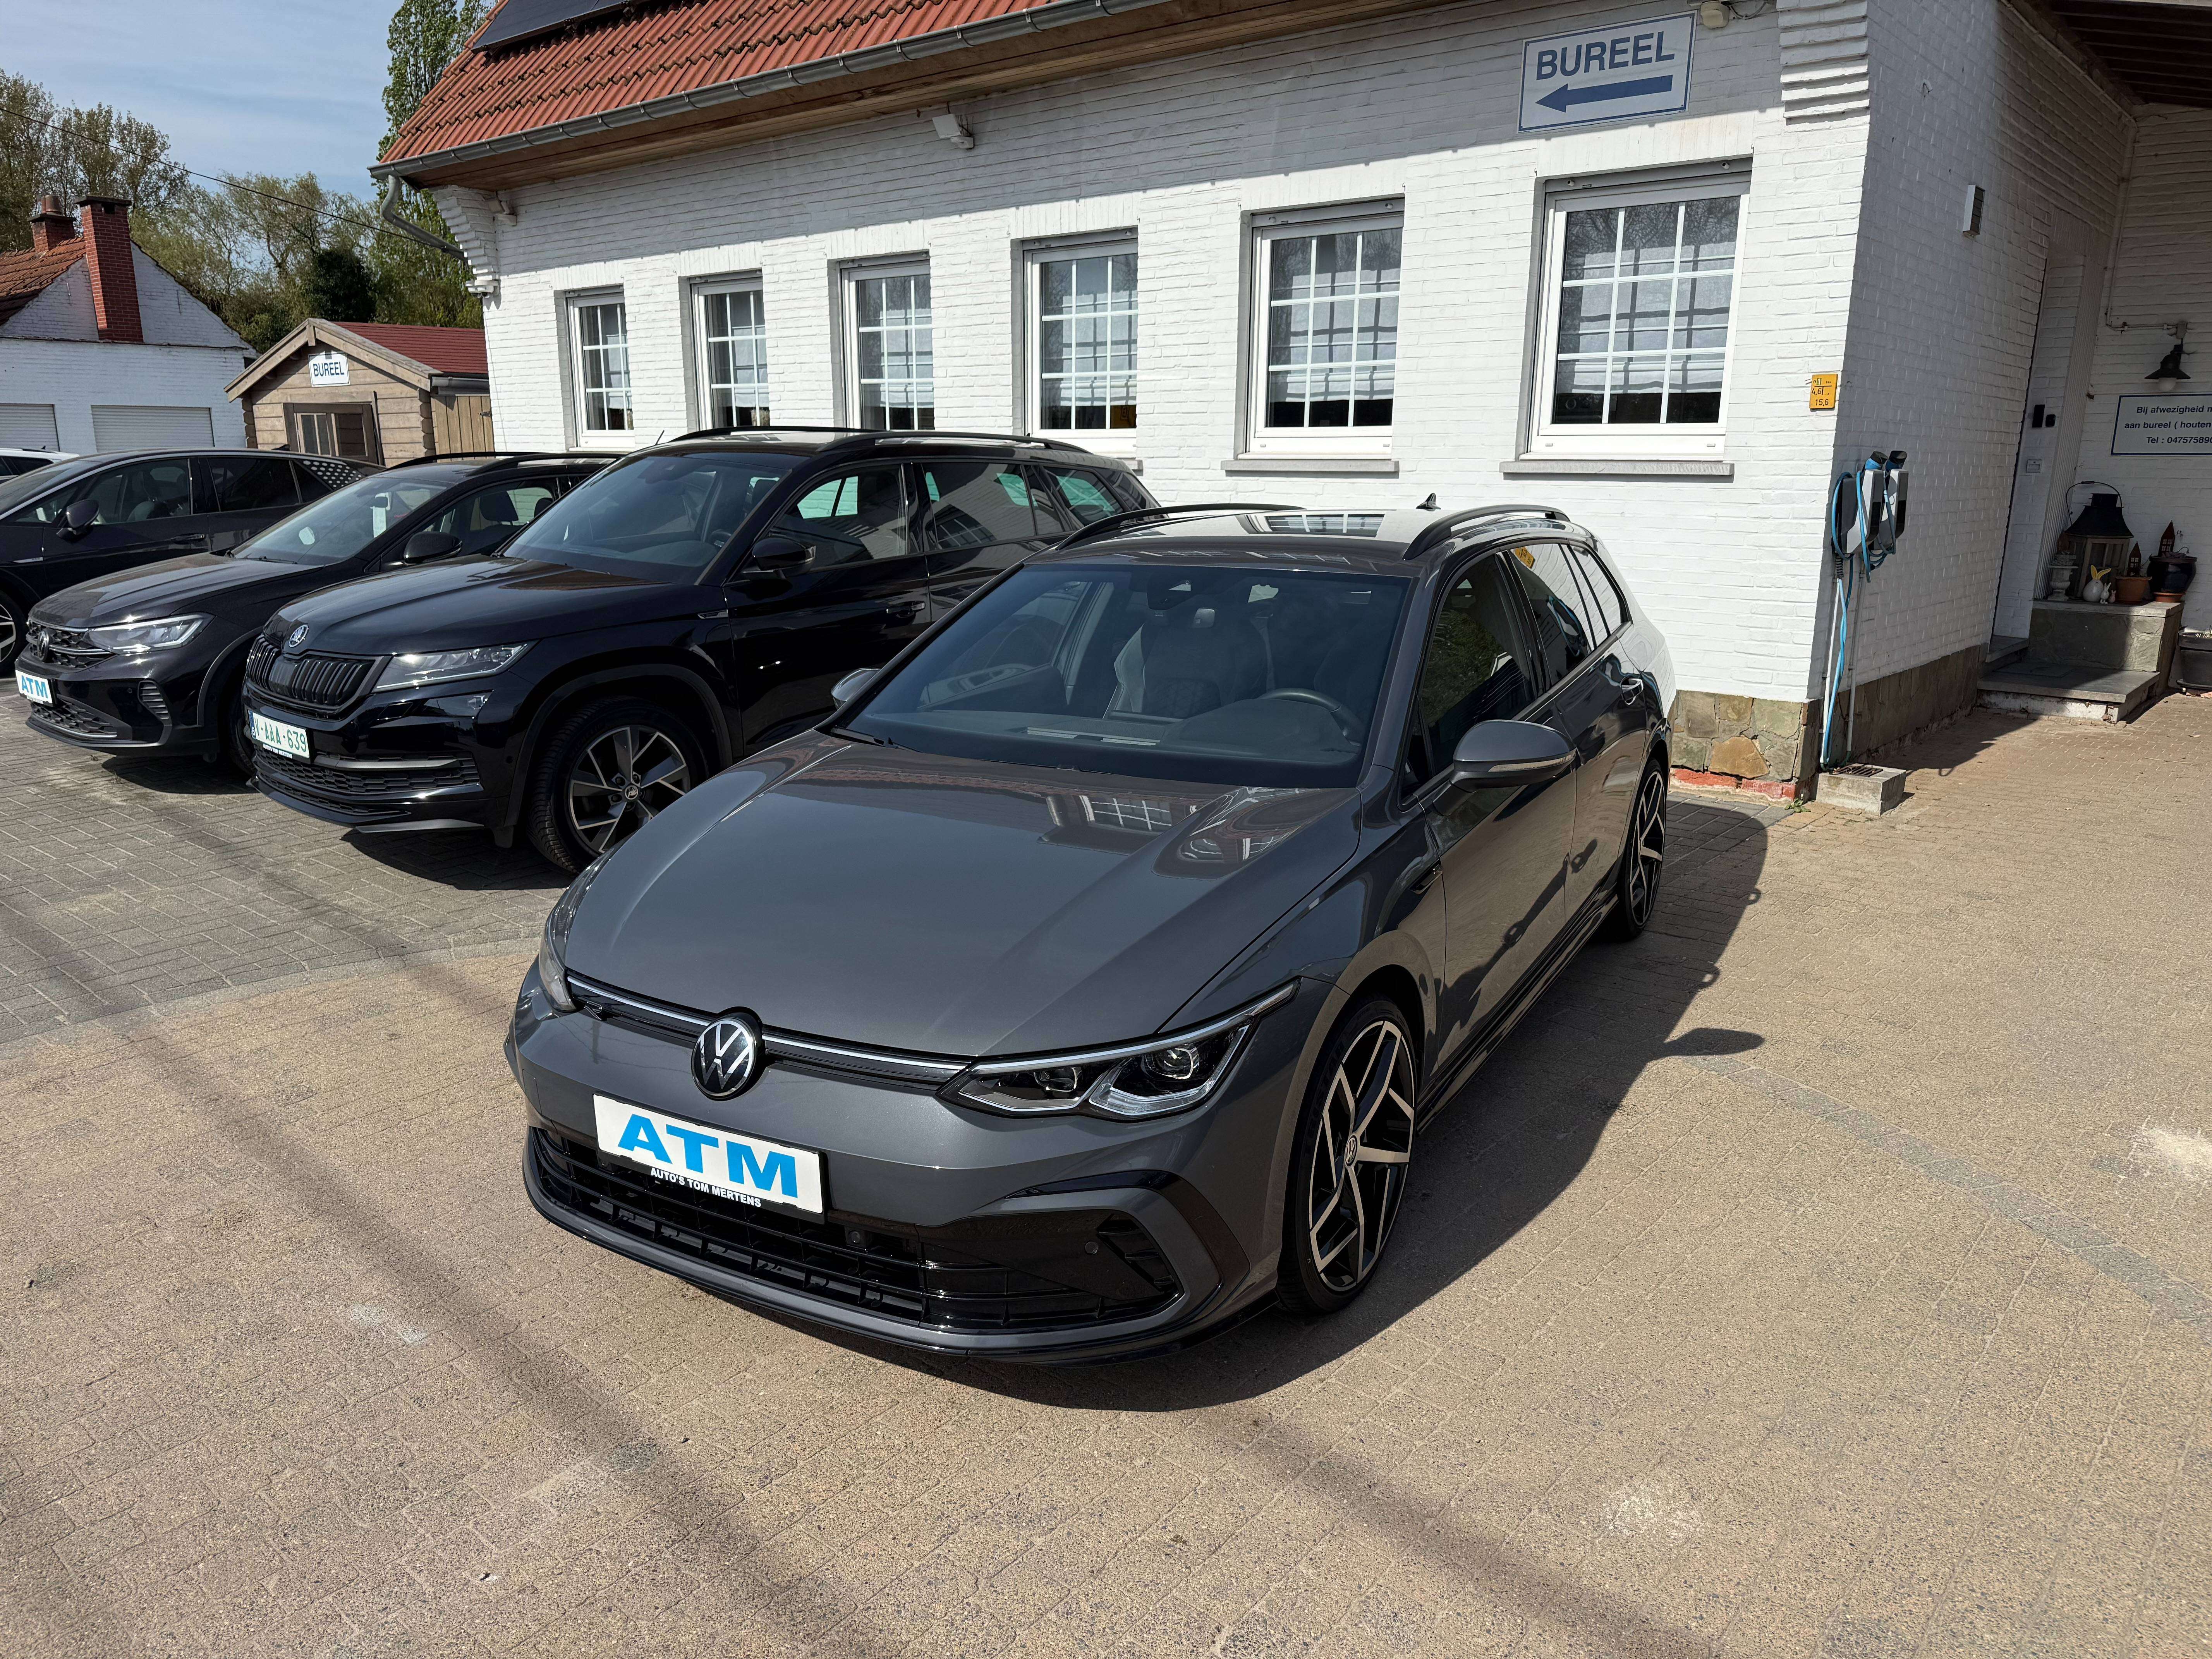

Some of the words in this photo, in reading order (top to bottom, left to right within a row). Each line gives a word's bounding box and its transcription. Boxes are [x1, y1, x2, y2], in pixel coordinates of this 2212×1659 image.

[1536, 31, 1675, 81] BUREEL
[313, 361, 345, 377] BUREEL
[2136, 406, 2148, 415] Bij
[2150, 405, 2204, 414] afwezigheid
[21, 675, 48, 699] ATM
[617, 1113, 798, 1199] ATM
[650, 1167, 685, 1186] AUTO'S
[687, 1179, 709, 1193] TOM
[711, 1186, 761, 1207] MERTENS
